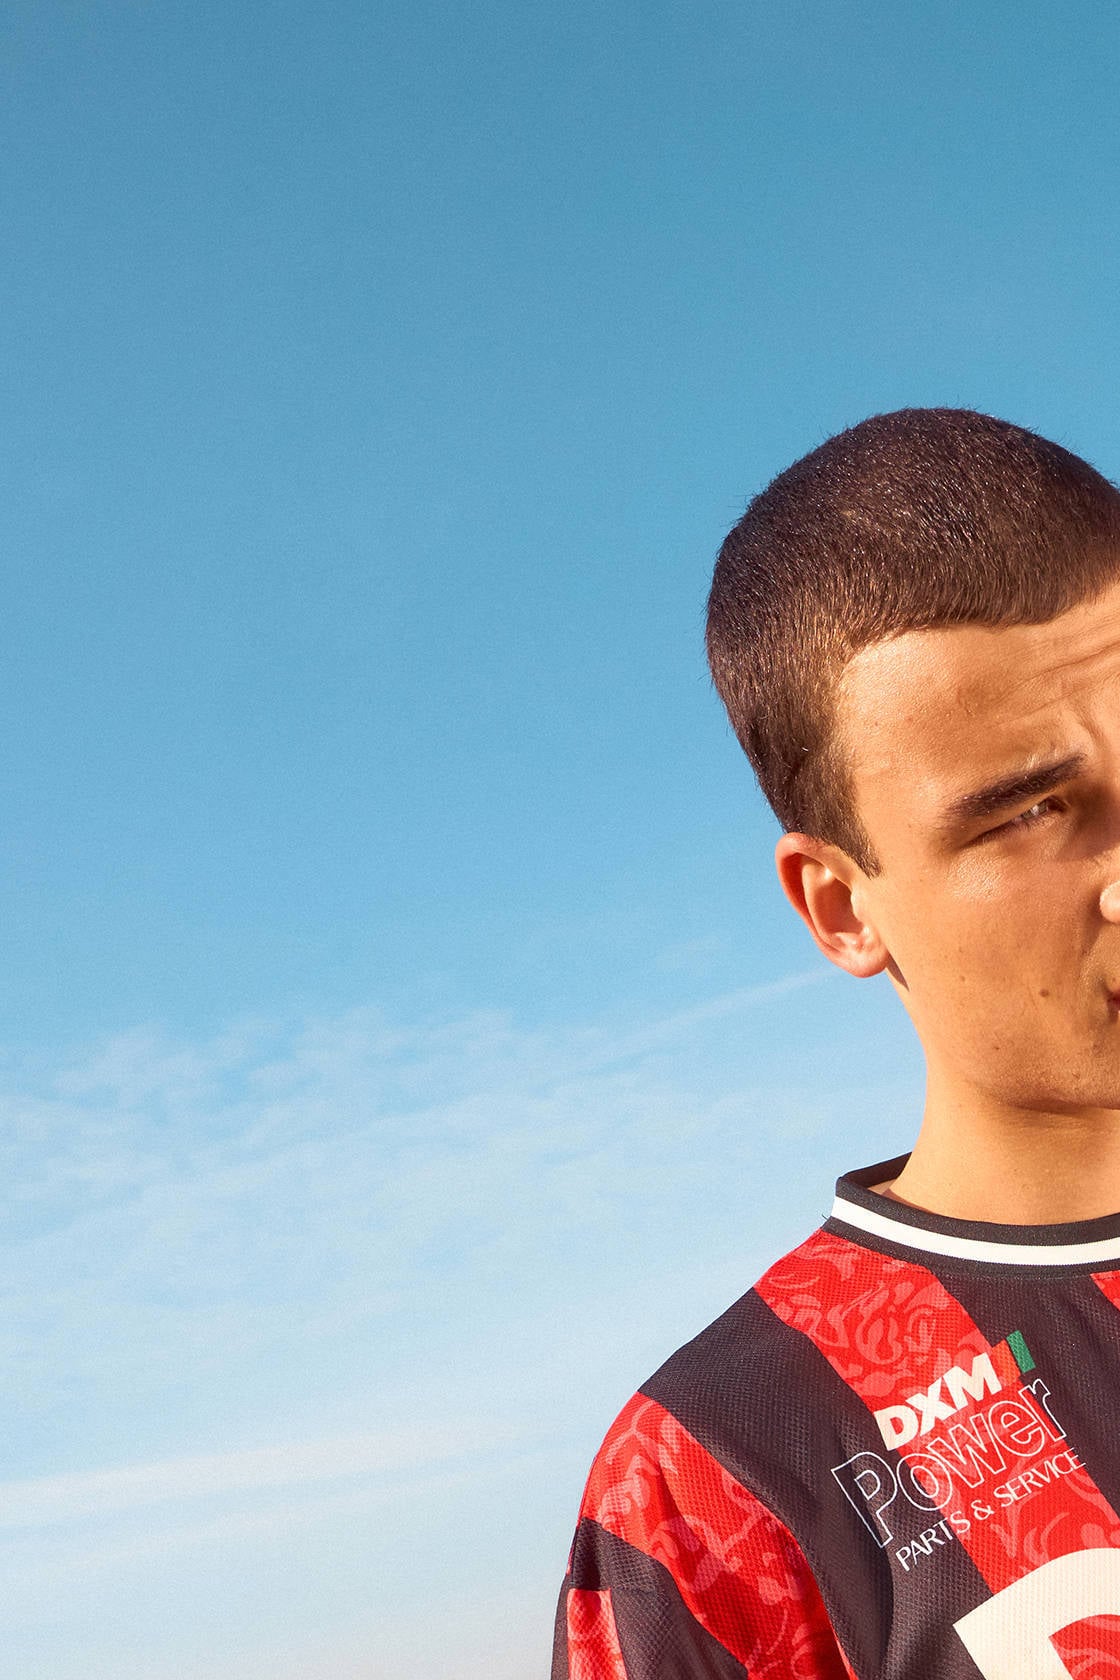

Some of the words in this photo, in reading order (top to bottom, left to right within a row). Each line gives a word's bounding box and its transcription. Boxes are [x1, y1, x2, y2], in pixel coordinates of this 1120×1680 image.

[830, 1378, 1067, 1548] Power
[873, 1352, 1002, 1451] DXM
[895, 1511, 971, 1572] PARTS
[970, 1499, 995, 1521] &
[993, 1447, 1087, 1507] SERVICE
